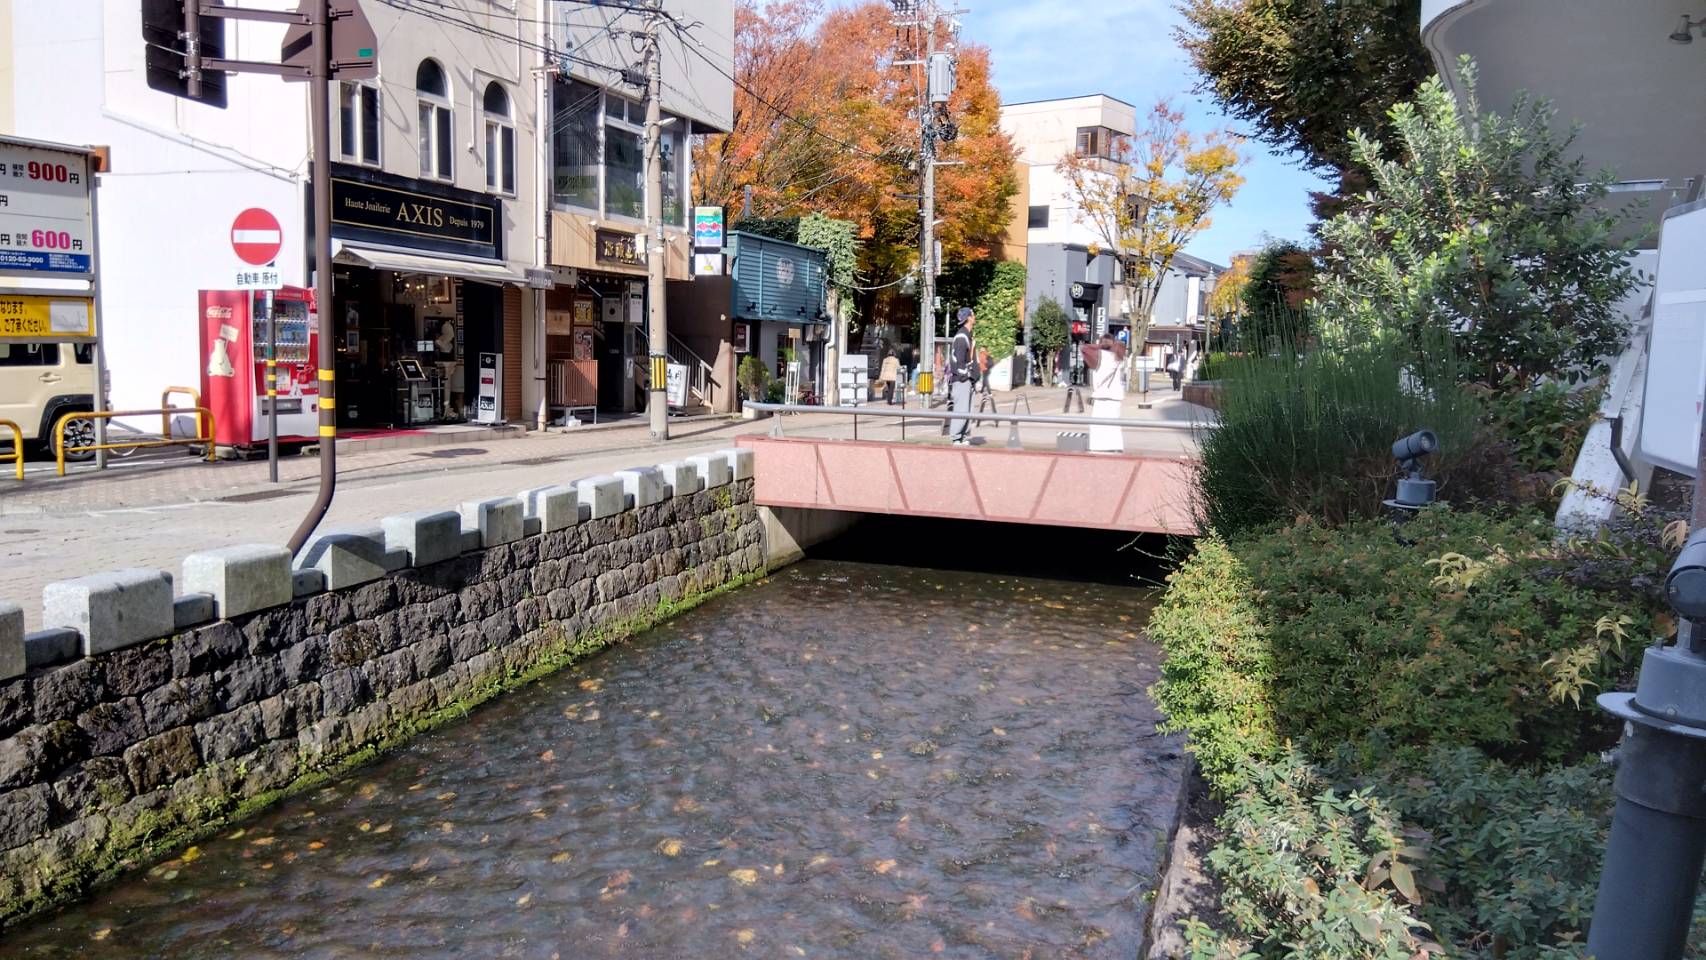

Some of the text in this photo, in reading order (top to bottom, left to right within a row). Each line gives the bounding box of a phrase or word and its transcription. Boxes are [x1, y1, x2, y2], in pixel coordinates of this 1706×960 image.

[396, 201, 443, 228] AXIS
[236, 271, 278, 286] 自動車 原付
